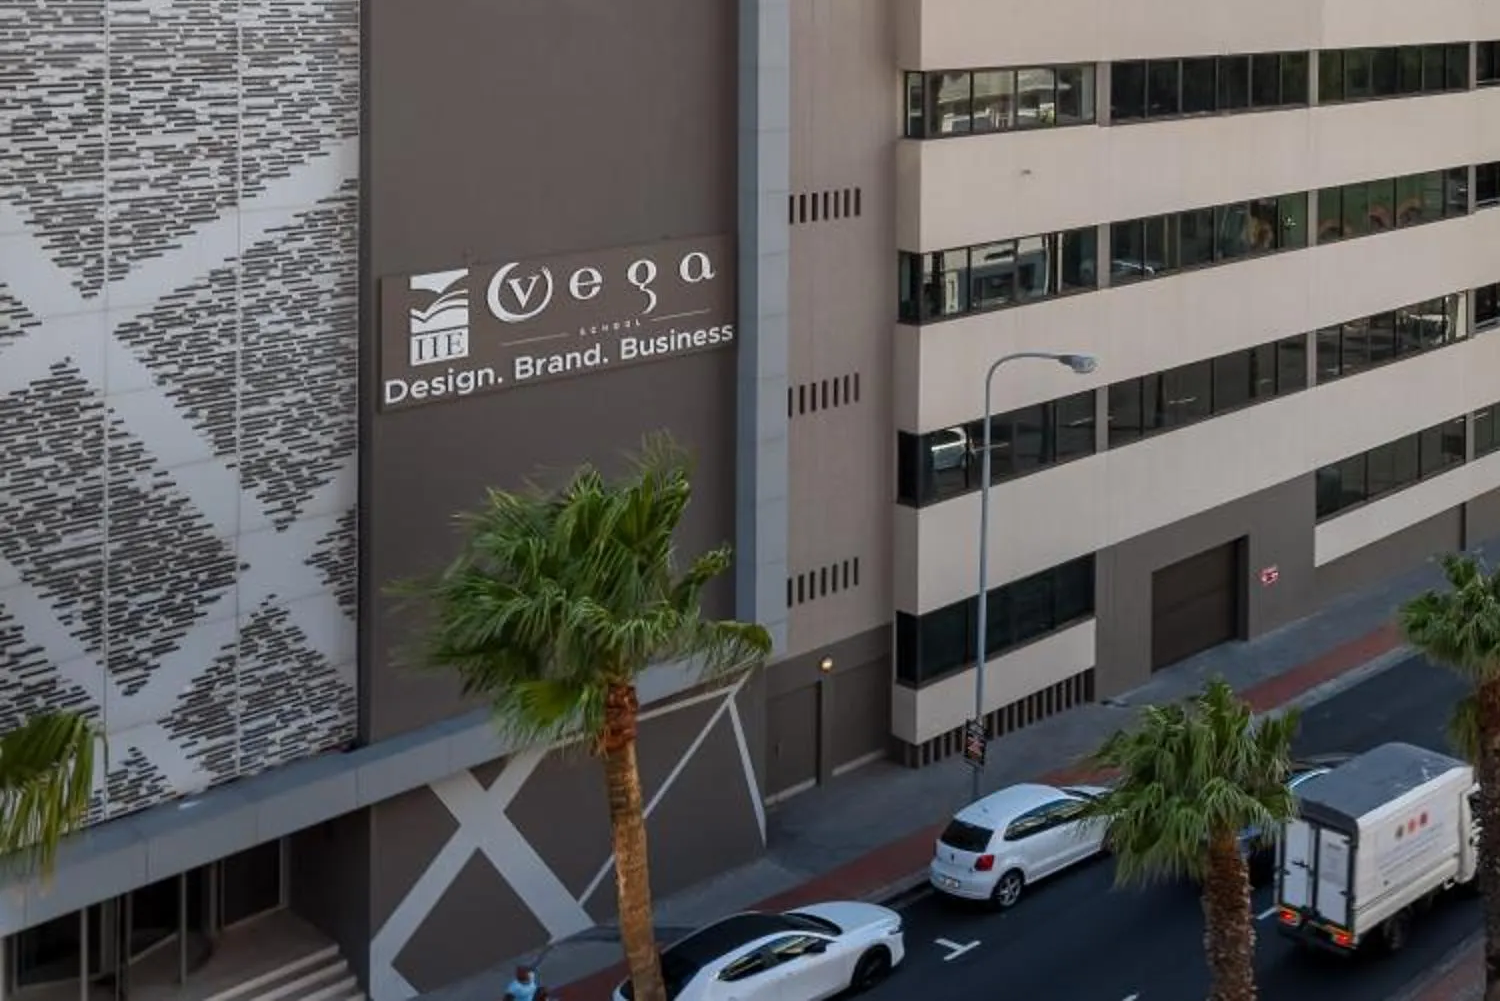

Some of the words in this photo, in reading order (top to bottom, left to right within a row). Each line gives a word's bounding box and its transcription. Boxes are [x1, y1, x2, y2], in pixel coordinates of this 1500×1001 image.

[384, 367, 504, 405] Design.
[515, 342, 609, 381] Brand.
[620, 322, 734, 361] Business
